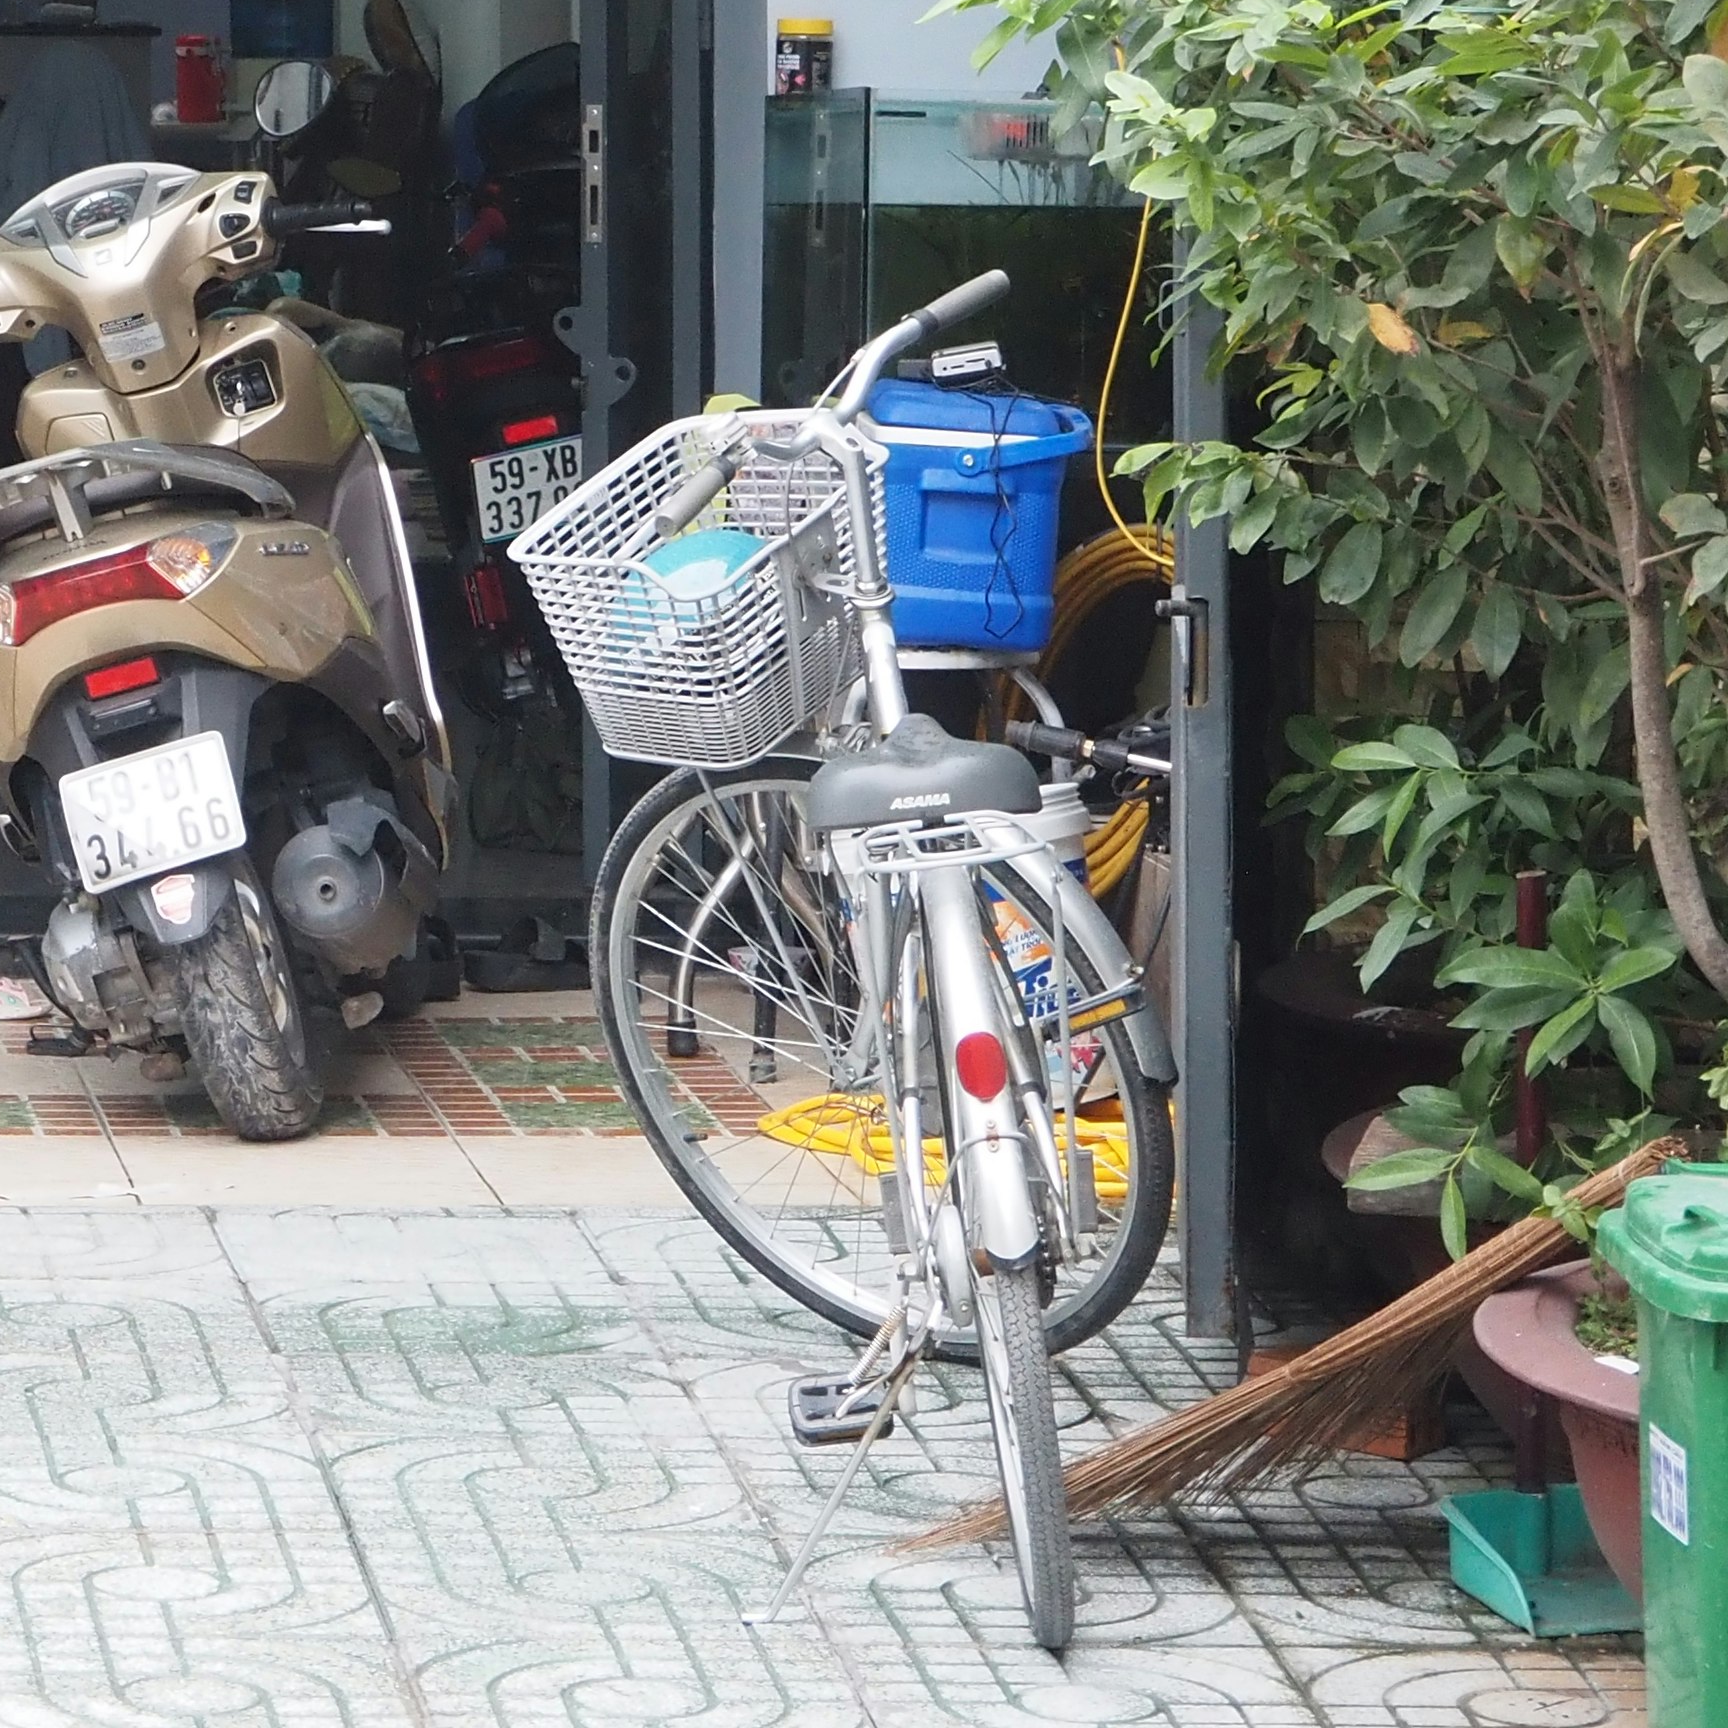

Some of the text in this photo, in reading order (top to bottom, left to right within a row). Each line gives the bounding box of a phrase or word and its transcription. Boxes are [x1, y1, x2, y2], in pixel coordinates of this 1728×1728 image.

[488, 444, 578, 494] 59-XB
[86, 750, 199, 822] 59-B1
[889, 792, 951, 810] ASAMA
